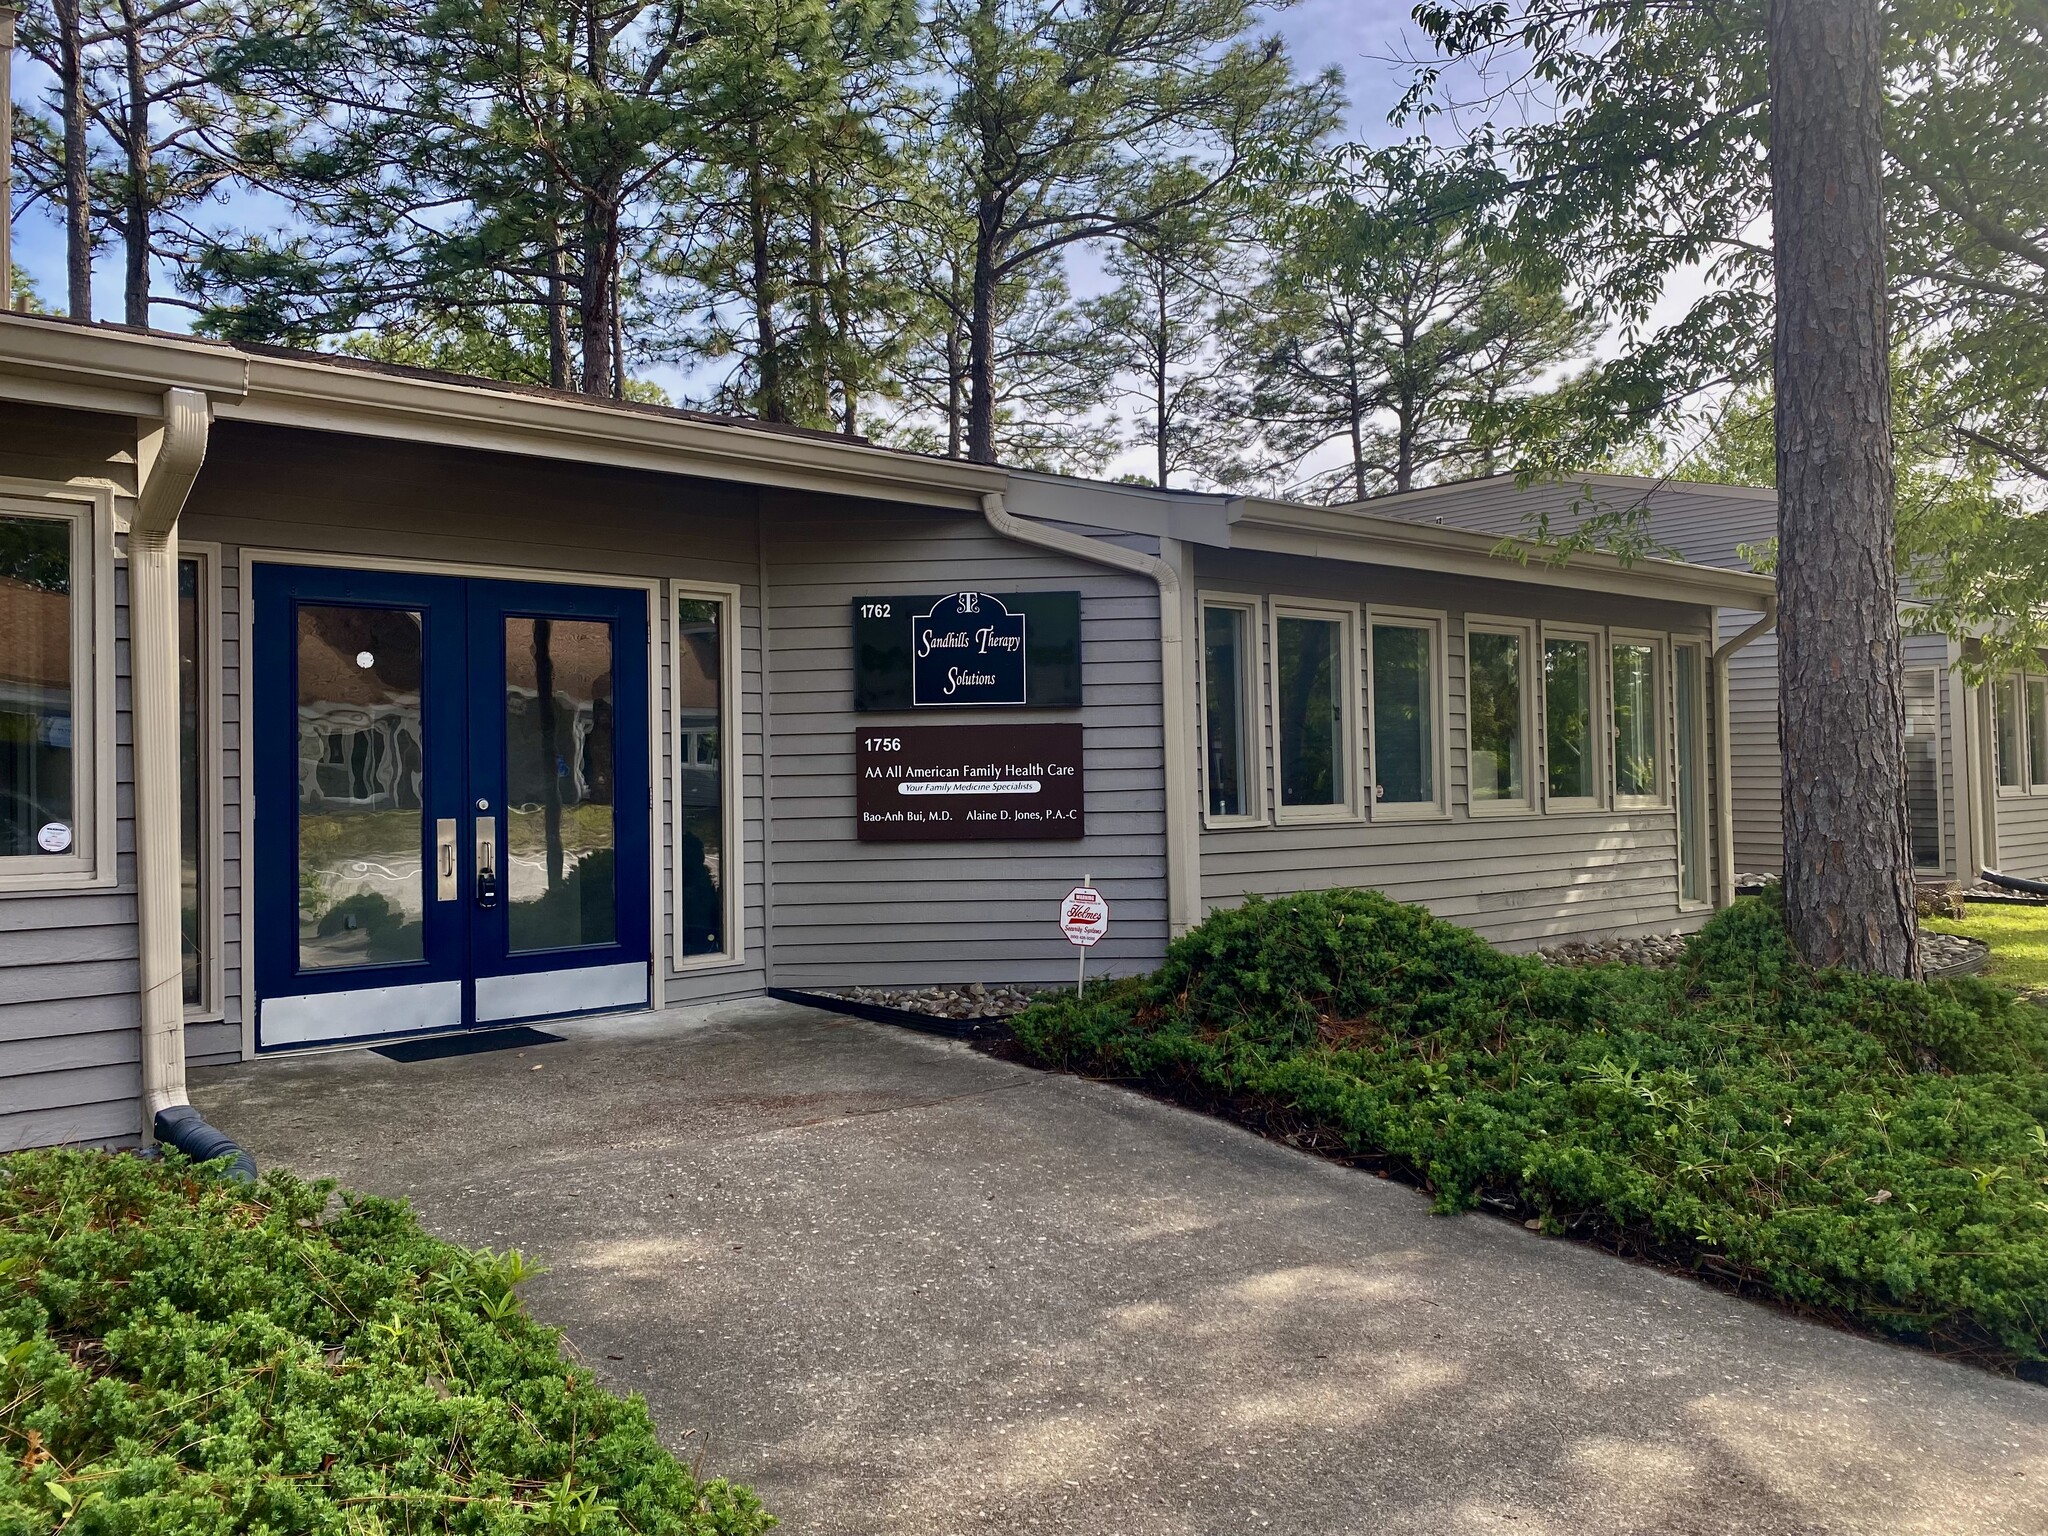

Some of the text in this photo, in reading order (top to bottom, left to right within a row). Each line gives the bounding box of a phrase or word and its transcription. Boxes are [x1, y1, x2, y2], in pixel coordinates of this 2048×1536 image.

[860, 604, 891, 618] 1762
[918, 625, 1020, 657] Sandhills Therapy
[943, 667, 995, 694] Solutions
[865, 738, 901, 751] 1756
[865, 764, 1075, 780] AA All American Family Health Care
[925, 784, 952, 792] Family
[953, 783, 990, 791] Medicine
[992, 783, 1033, 791] Specialists
[863, 810, 1077, 822] Bao-Anh Bui, M.D. Alaine D. Jones, P.A.-C
[1067, 904, 1101, 920] Holmes
